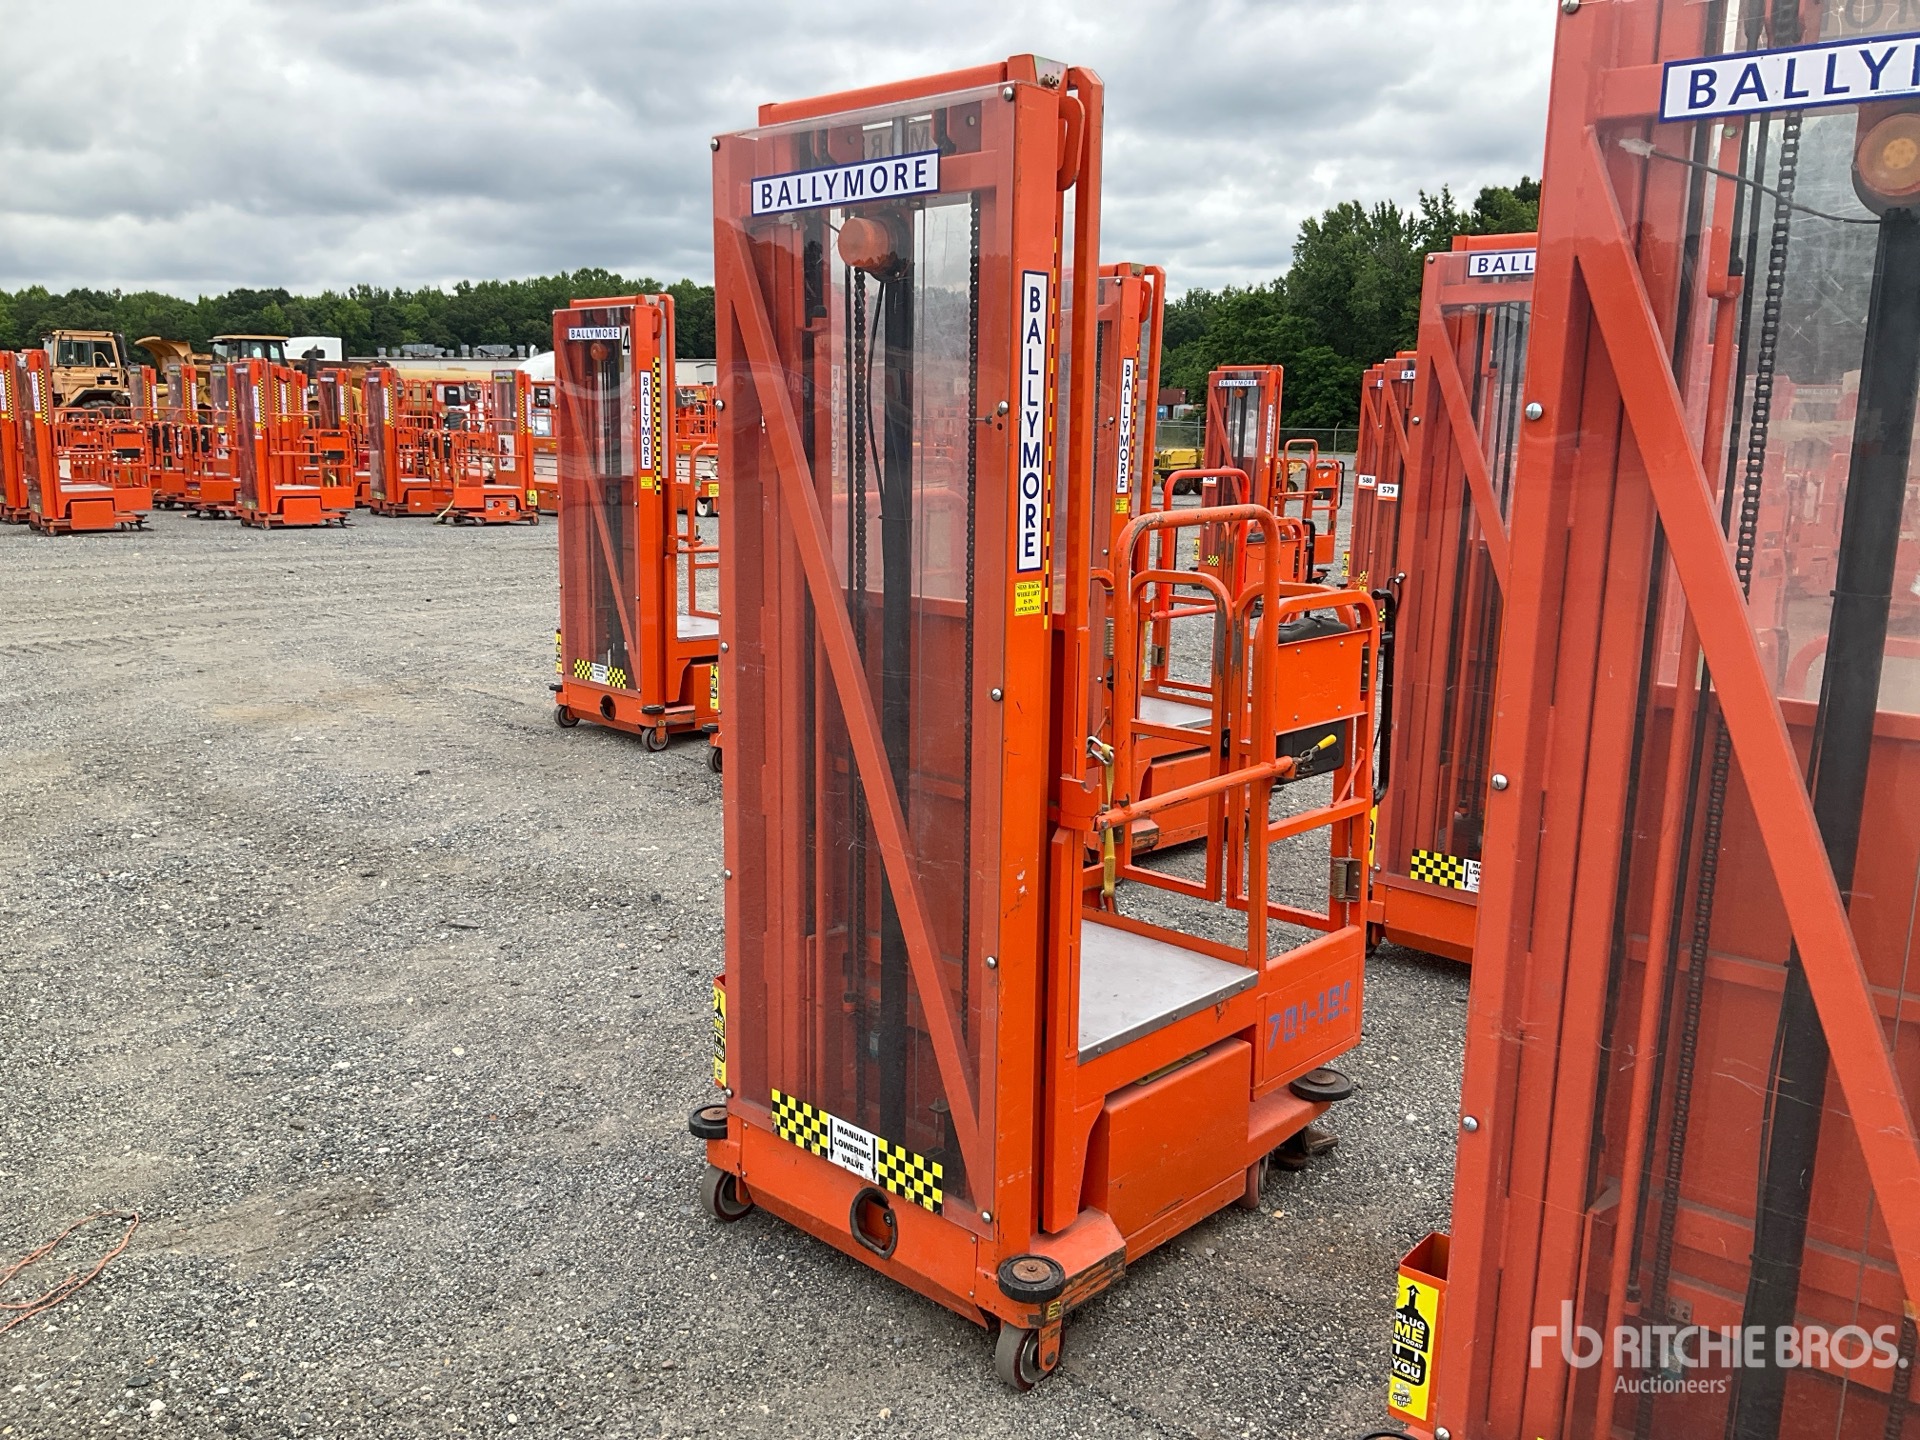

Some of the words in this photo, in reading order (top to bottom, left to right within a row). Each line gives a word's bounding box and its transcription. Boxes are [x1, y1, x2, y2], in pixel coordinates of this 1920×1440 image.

[1687, 44, 1920, 109] BALLY
[761, 159, 927, 209] BALLYMORE
[1477, 255, 1533, 273] BALL
[570, 328, 618, 339] BALLYMORE
[622, 327, 630, 353] 4
[641, 376, 651, 466] BALLYMORE
[1022, 286, 1042, 558] BALLYMORE
[1119, 364, 1131, 489] BALLYMORE
[1362, 476, 1373, 484] 580
[1382, 486, 1395, 494] 579
[714, 1018, 725, 1032] ME
[714, 1045, 725, 1058] YOU
[836, 1124, 869, 1146] MANUAL
[834, 1137, 871, 1161] LOWERING
[841, 1154, 864, 1172] VALVE
[1395, 1312, 1426, 1331] PLUG
[1394, 1321, 1425, 1344] ME
[1401, 1336, 1423, 1350] TODAY
[1392, 1357, 1421, 1378] YOU
